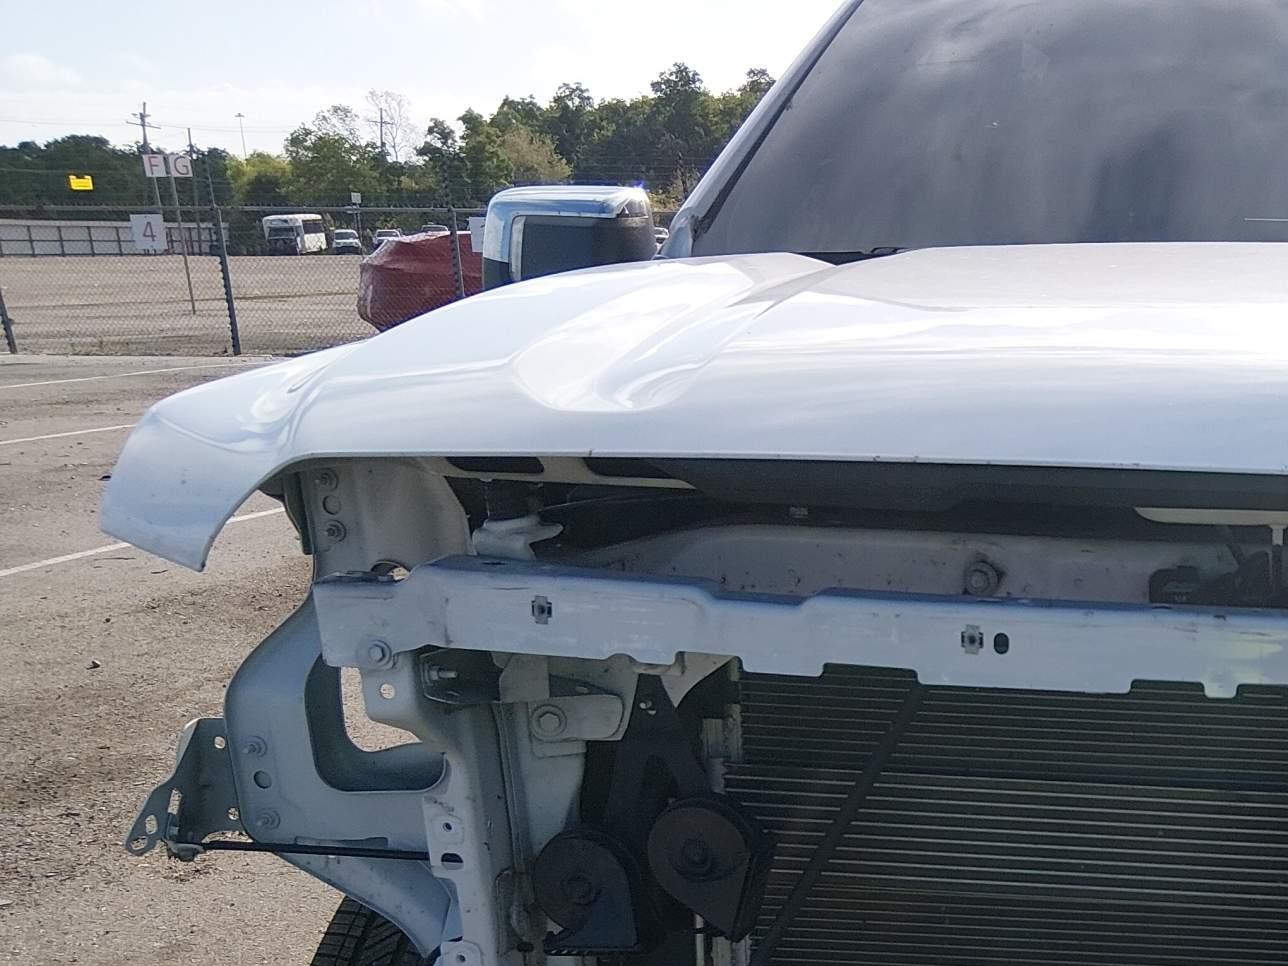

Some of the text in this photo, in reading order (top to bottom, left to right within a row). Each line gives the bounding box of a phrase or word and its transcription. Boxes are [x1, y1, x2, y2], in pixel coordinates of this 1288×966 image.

[148, 156, 160, 175] F
[174, 156, 190, 175] G
[143, 221, 156, 242] 4
